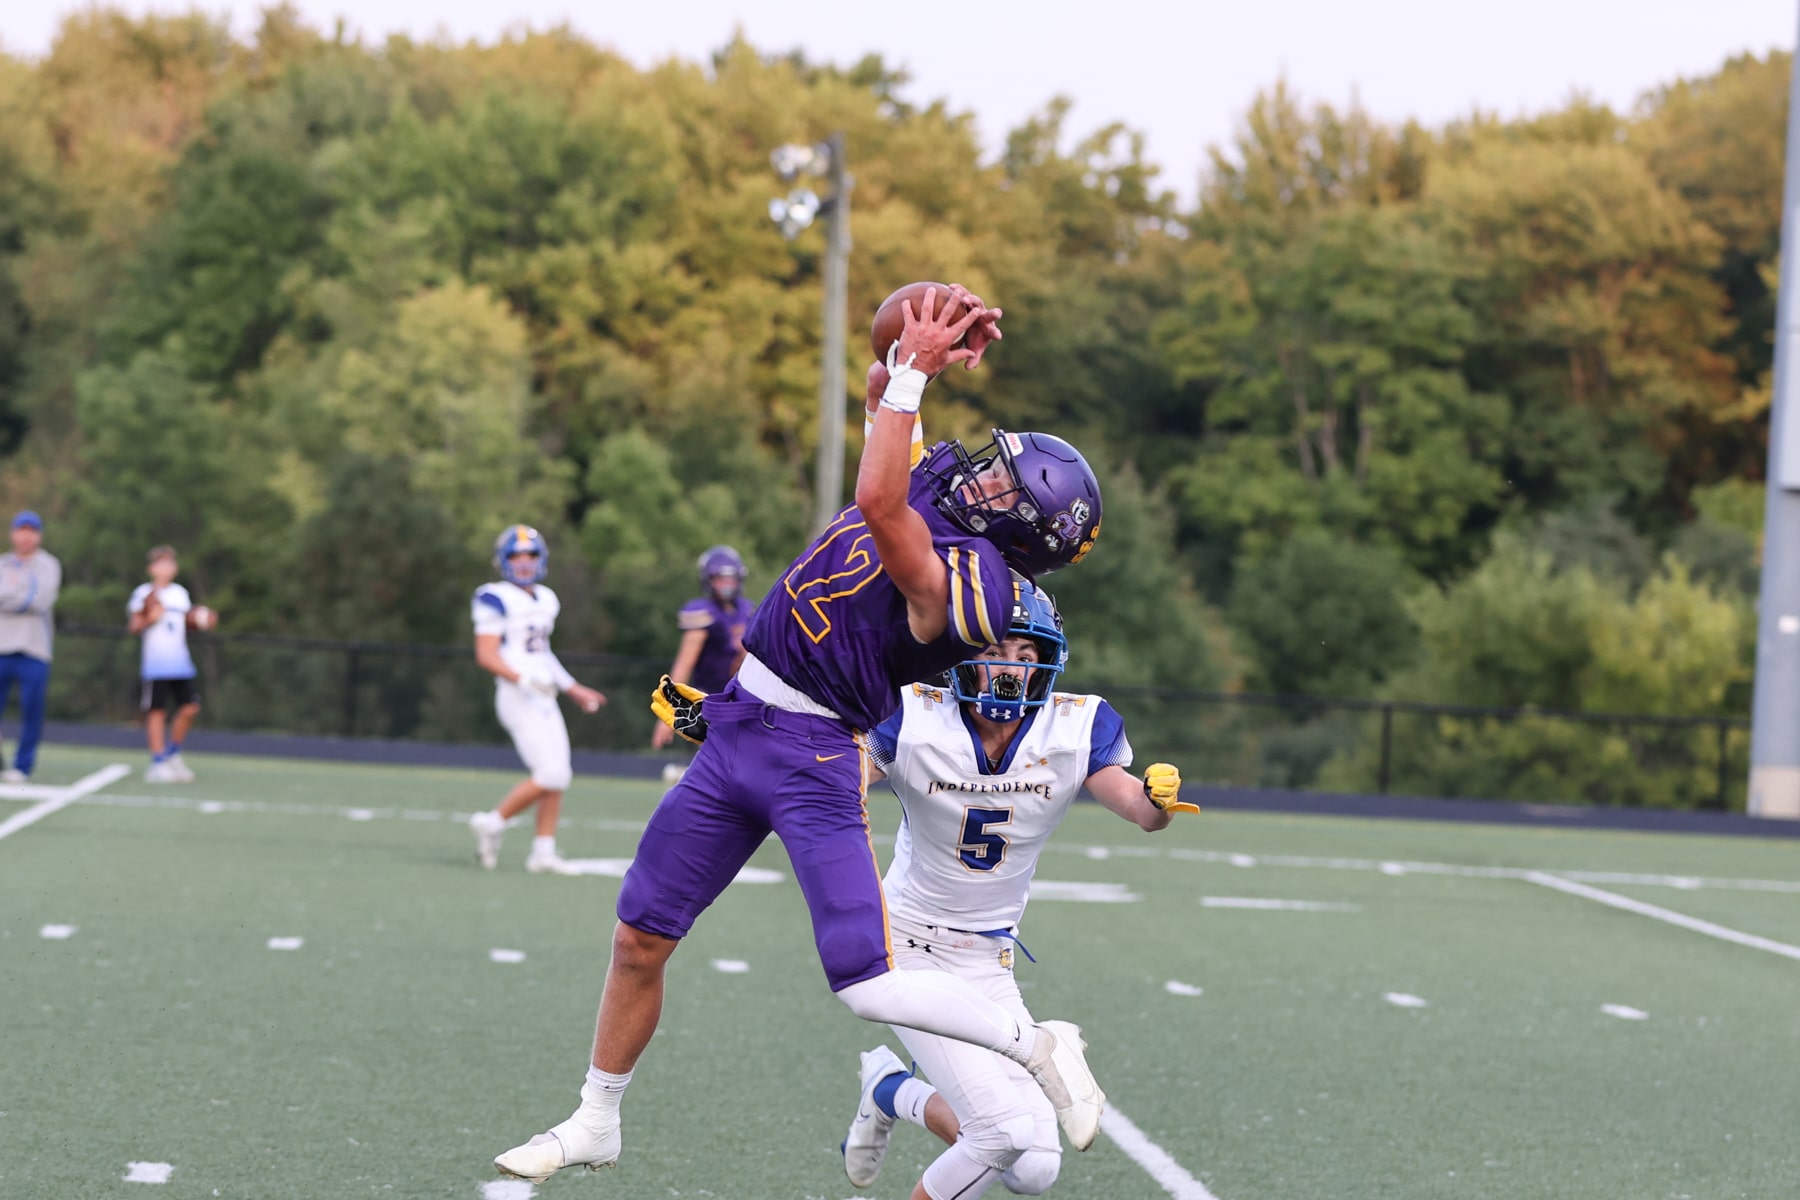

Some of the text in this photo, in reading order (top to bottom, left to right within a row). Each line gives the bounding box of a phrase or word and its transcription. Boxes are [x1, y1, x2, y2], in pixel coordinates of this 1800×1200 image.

[783, 504, 884, 645] 12
[927, 780, 1054, 801] INDEPENDENCE
[956, 804, 1014, 873] 5
